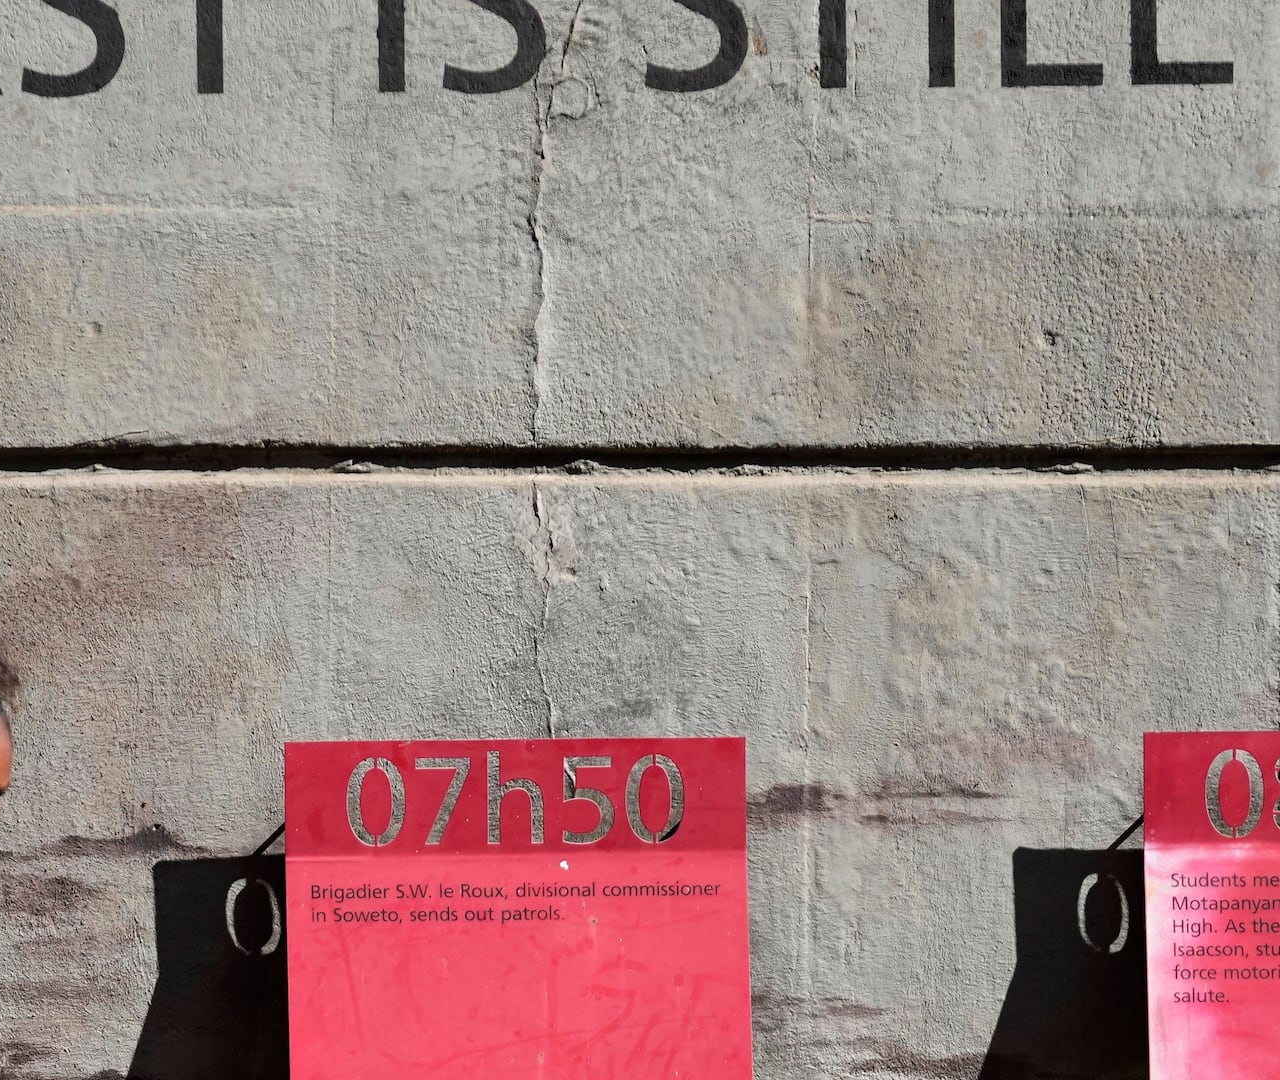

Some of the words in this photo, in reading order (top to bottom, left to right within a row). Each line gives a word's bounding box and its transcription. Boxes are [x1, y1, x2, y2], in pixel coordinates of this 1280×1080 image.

[346, 750, 685, 847] 07h50
[1170, 871, 1247, 888] Students
[310, 883, 390, 903] Brigadier
[395, 883, 433, 900] S.W.
[439, 882, 454, 899] le
[460, 883, 509, 901] Roux,
[515, 880, 596, 899] divisional
[602, 880, 721, 897] commissioner
[311, 906, 327, 923] in
[332, 906, 403, 925] Soweto,
[409, 905, 459, 923] sends
[464, 906, 495, 923] out
[501, 903, 565, 925] patrols.
[1172, 918, 1219, 938] High.
[1224, 918, 1246, 934] As
[1173, 941, 1249, 960] Isaacson,
[1173, 963, 1217, 980] force
[1173, 986, 1230, 1004] salute.
